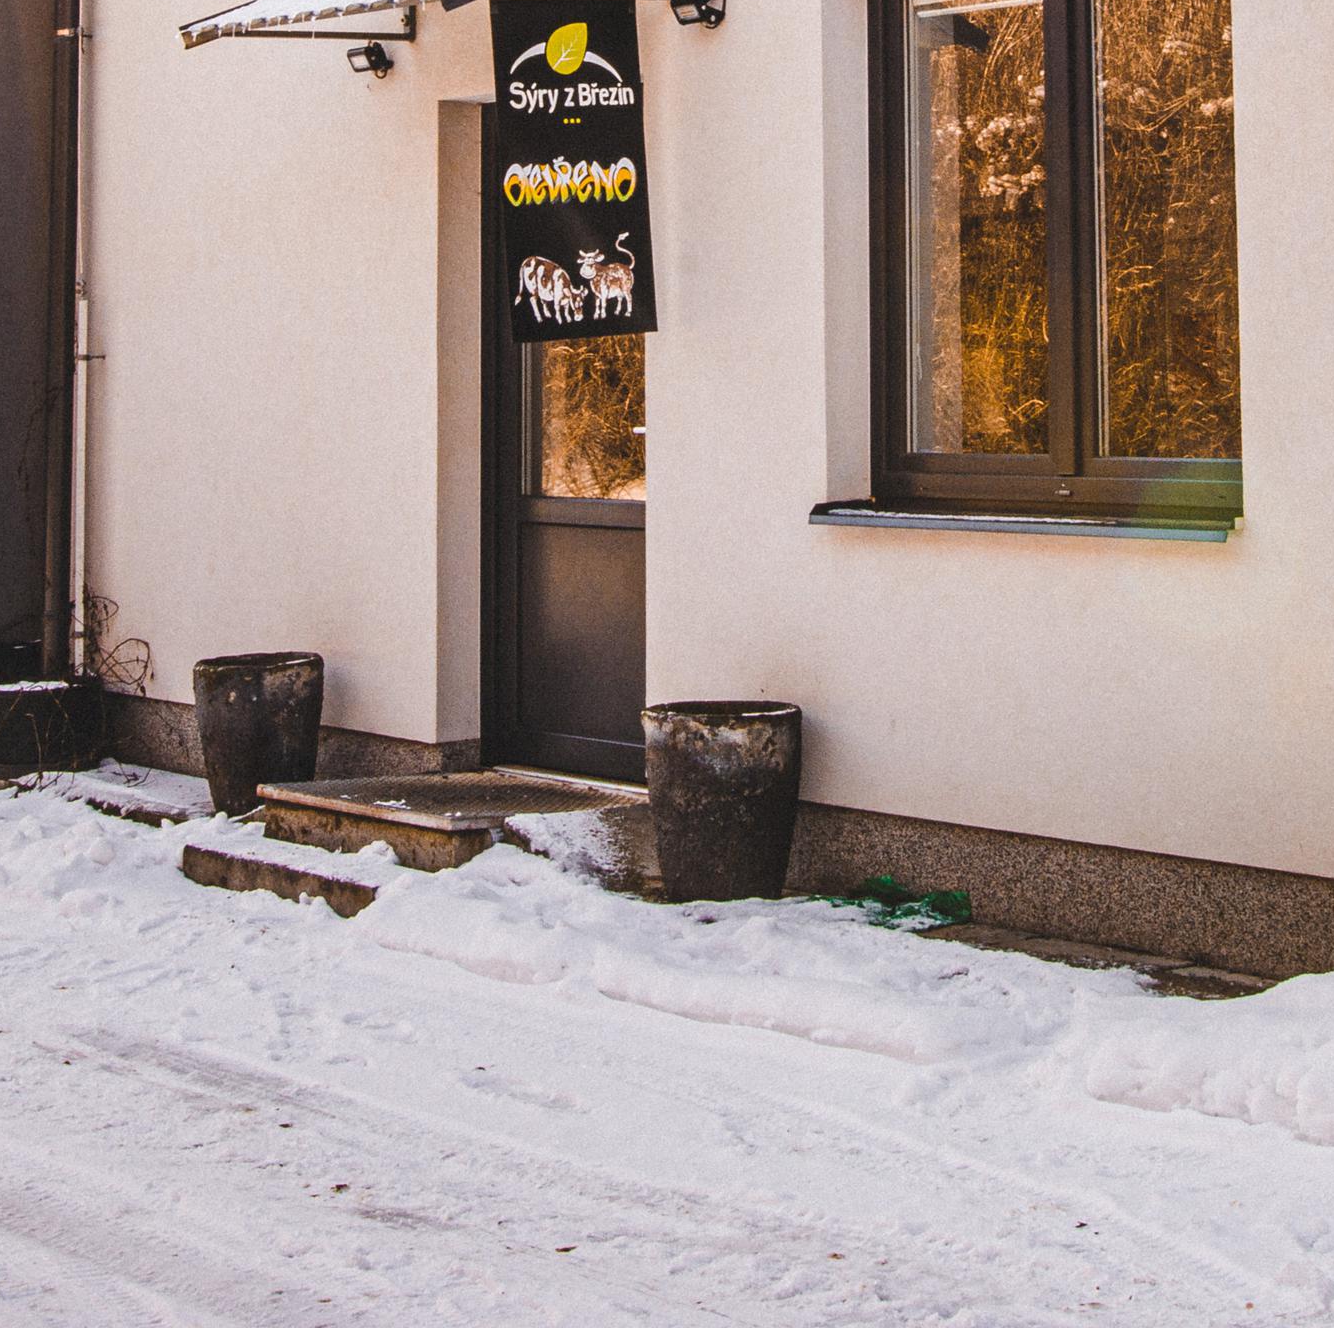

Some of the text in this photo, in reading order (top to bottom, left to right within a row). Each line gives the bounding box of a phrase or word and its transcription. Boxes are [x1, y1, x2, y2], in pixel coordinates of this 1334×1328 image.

[509, 81, 635, 114] Sýry z Březin
